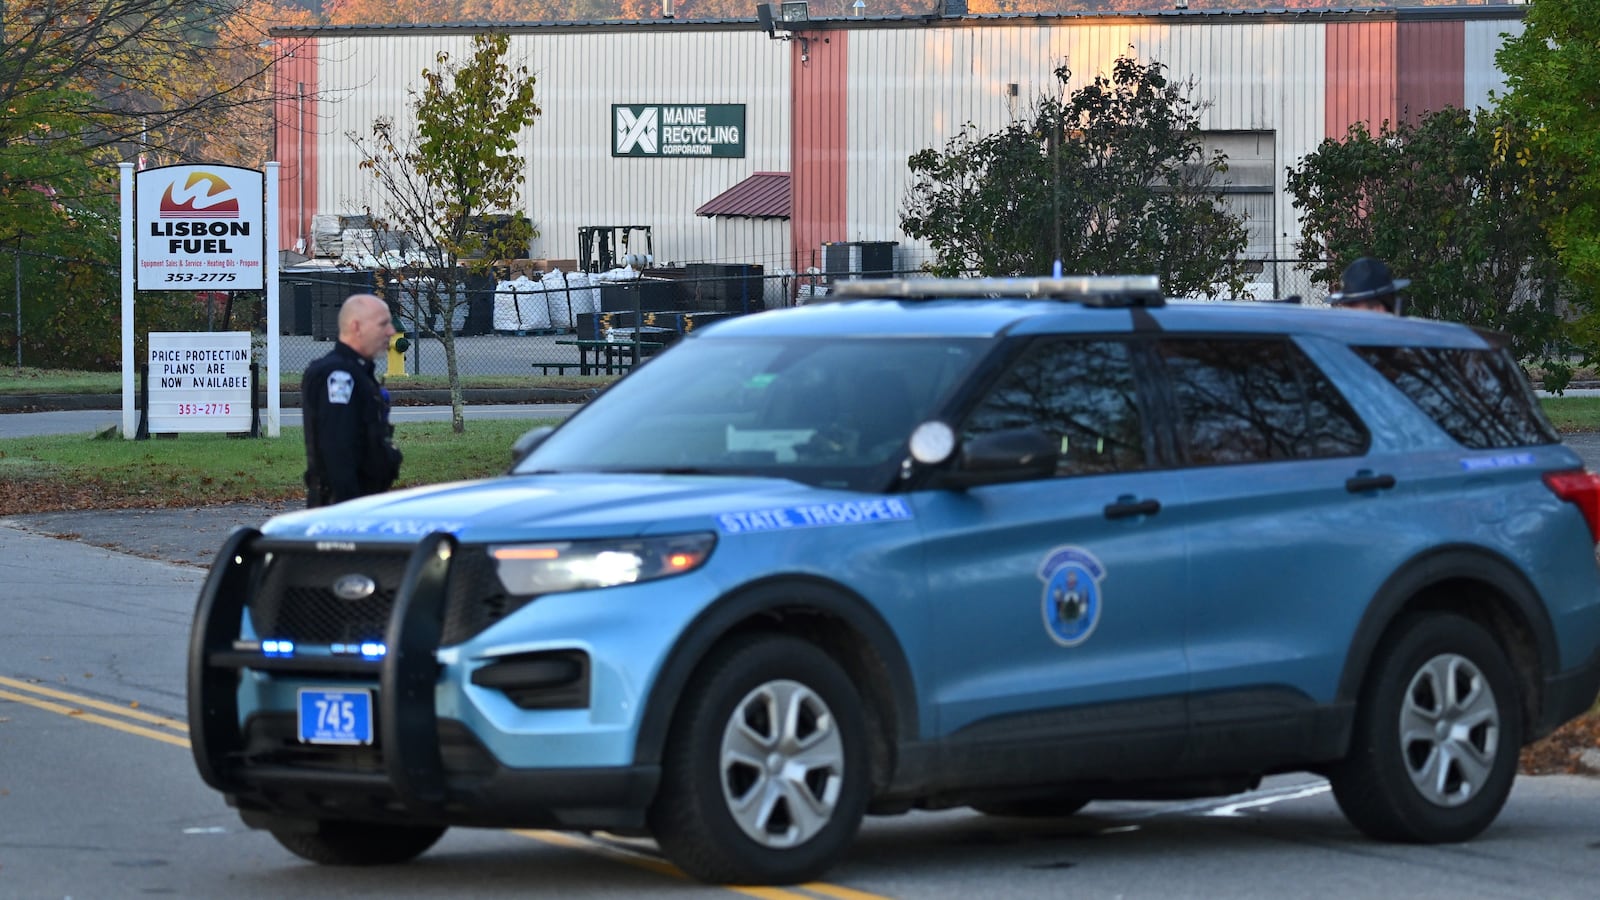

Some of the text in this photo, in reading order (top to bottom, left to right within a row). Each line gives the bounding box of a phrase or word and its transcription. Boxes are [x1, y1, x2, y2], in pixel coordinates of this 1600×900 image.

[662, 107, 706, 125] MAINE
[662, 126, 739, 144] RECYCLING
[662, 145, 712, 154] CORPORATION
[151, 222, 250, 236] LISBON
[169, 239, 233, 254] FUEL
[141, 260, 164, 268] Equipment
[207, 260, 225, 268] Heating
[226, 259, 235, 267] Oils
[240, 260, 259, 268] Propane
[165, 273, 237, 282] 353-2775
[152, 350, 247, 361] PRICE PROTECTION
[164, 364, 225, 374] PLANS ARE
[161, 377, 182, 388] NOW
[179, 404, 230, 414] 353-2775
[720, 498, 908, 533] STATE TROOPER
[315, 701, 355, 732] 745
